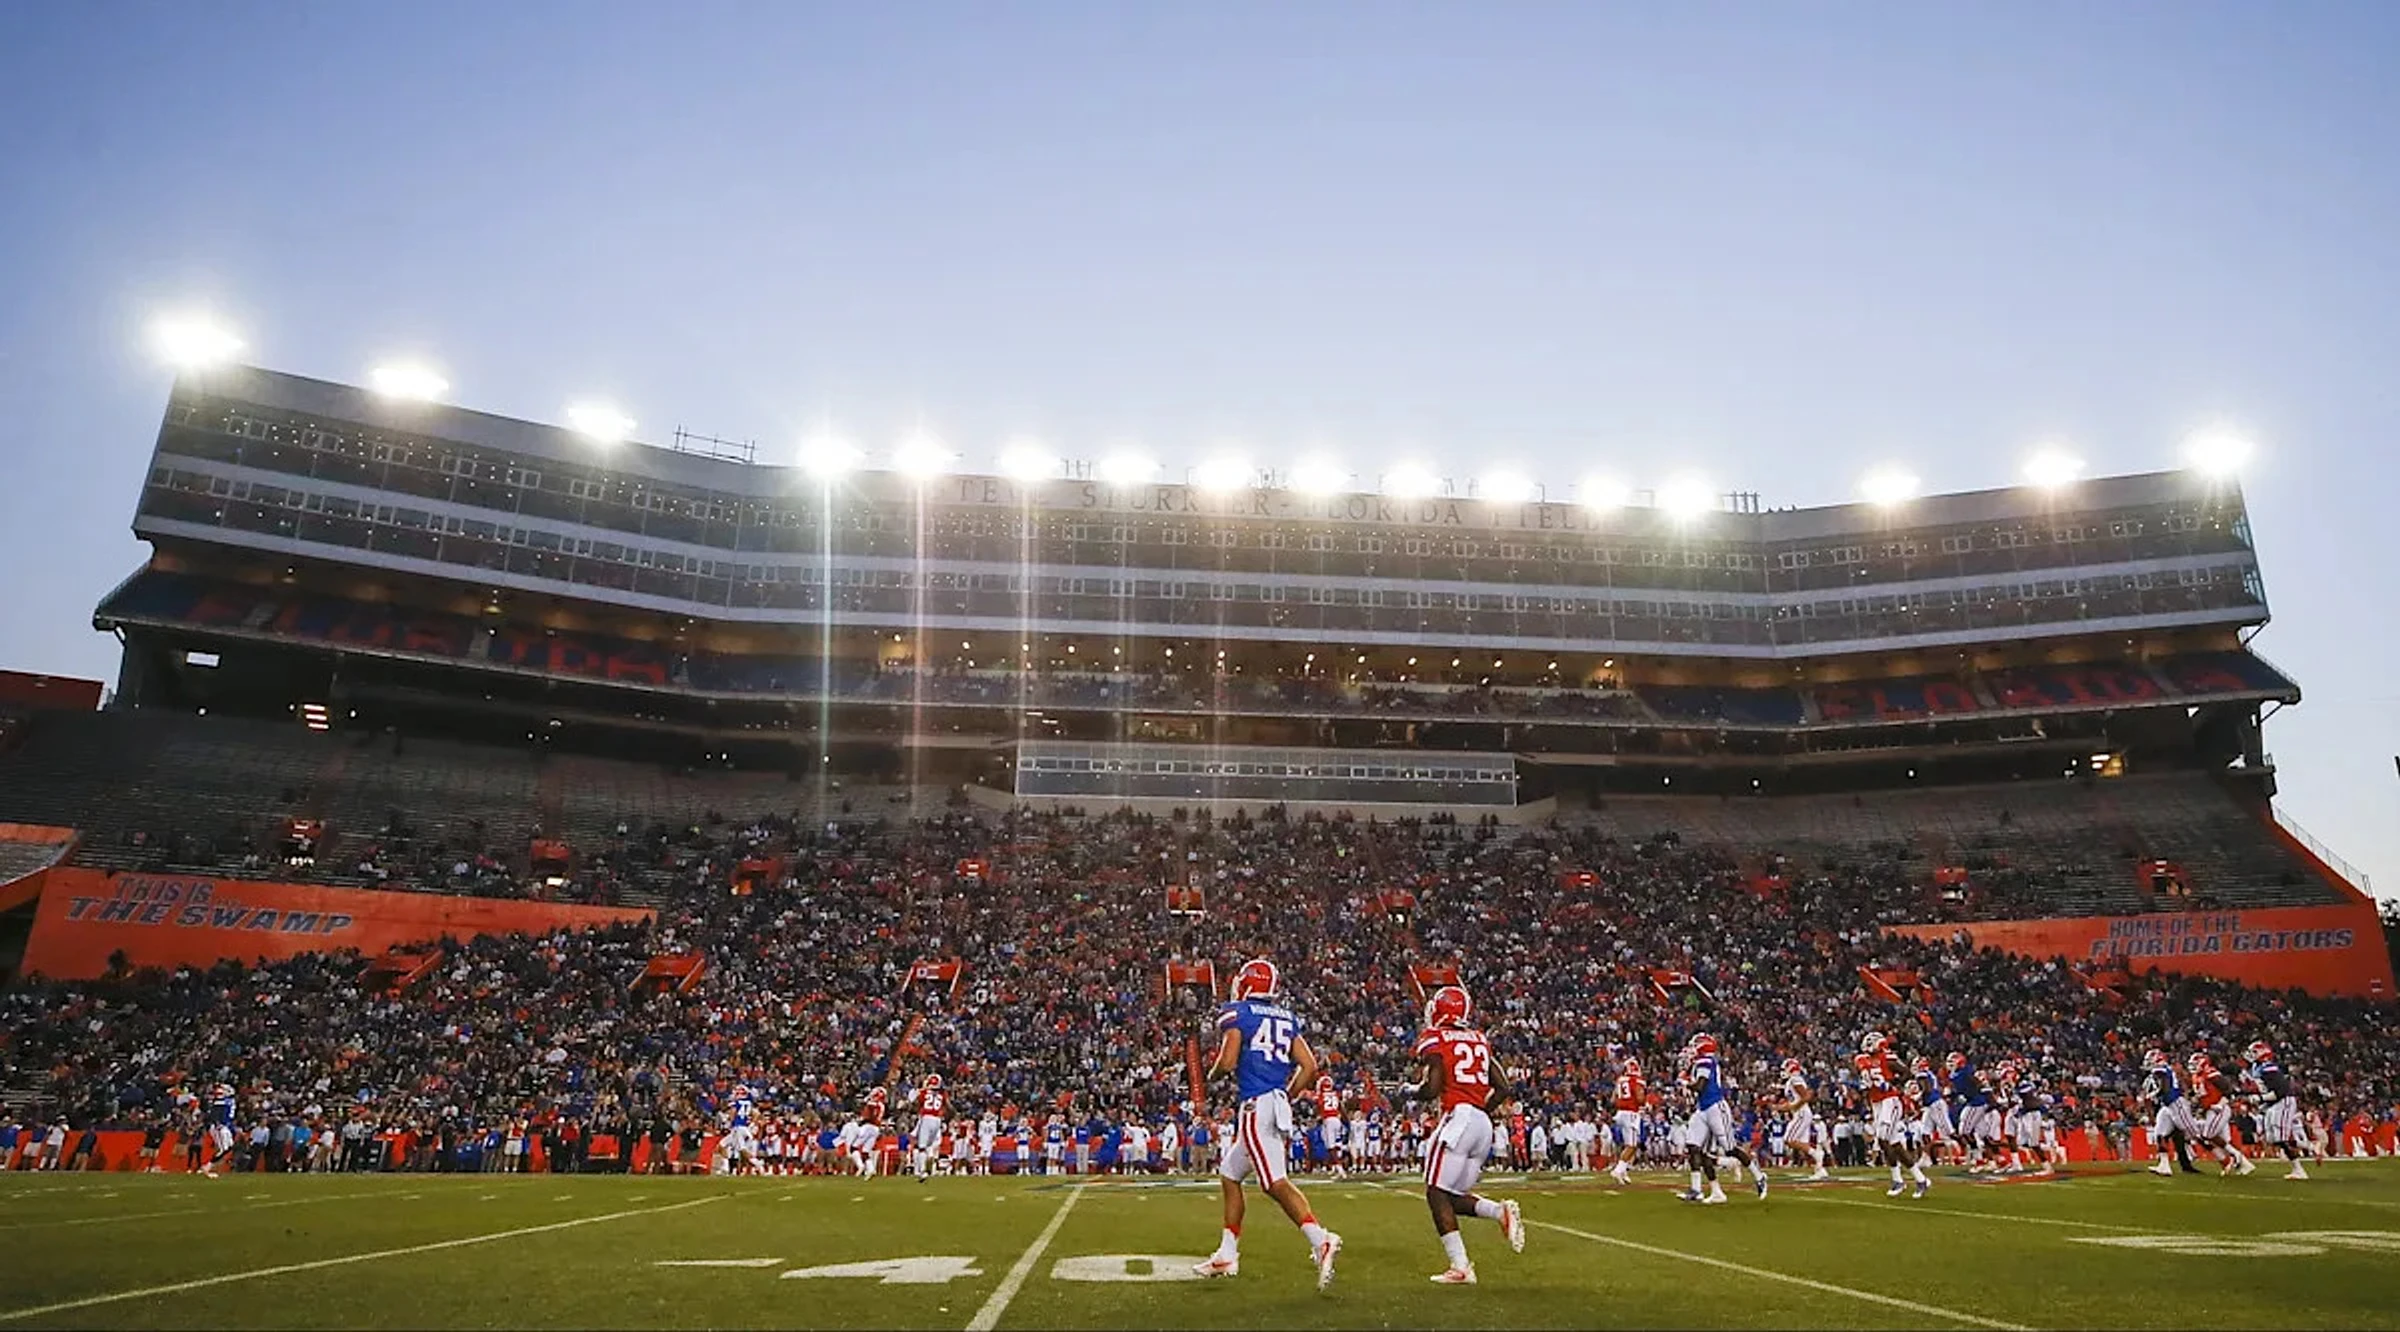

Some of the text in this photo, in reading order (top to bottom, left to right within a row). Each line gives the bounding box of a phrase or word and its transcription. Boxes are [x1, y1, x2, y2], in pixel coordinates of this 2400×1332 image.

[115, 876, 215, 902] THIS IS
[66, 896, 352, 936] THE SWAMP
[2109, 913, 2241, 939] HOME OF THE
[2090, 928, 2354, 958] FLORIDA GATORS
[1250, 1017, 1293, 1064] 45
[1453, 1042, 1490, 1085] 23
[923, 1093, 943, 1111] 26
[780, 1254, 1208, 1283] 40
